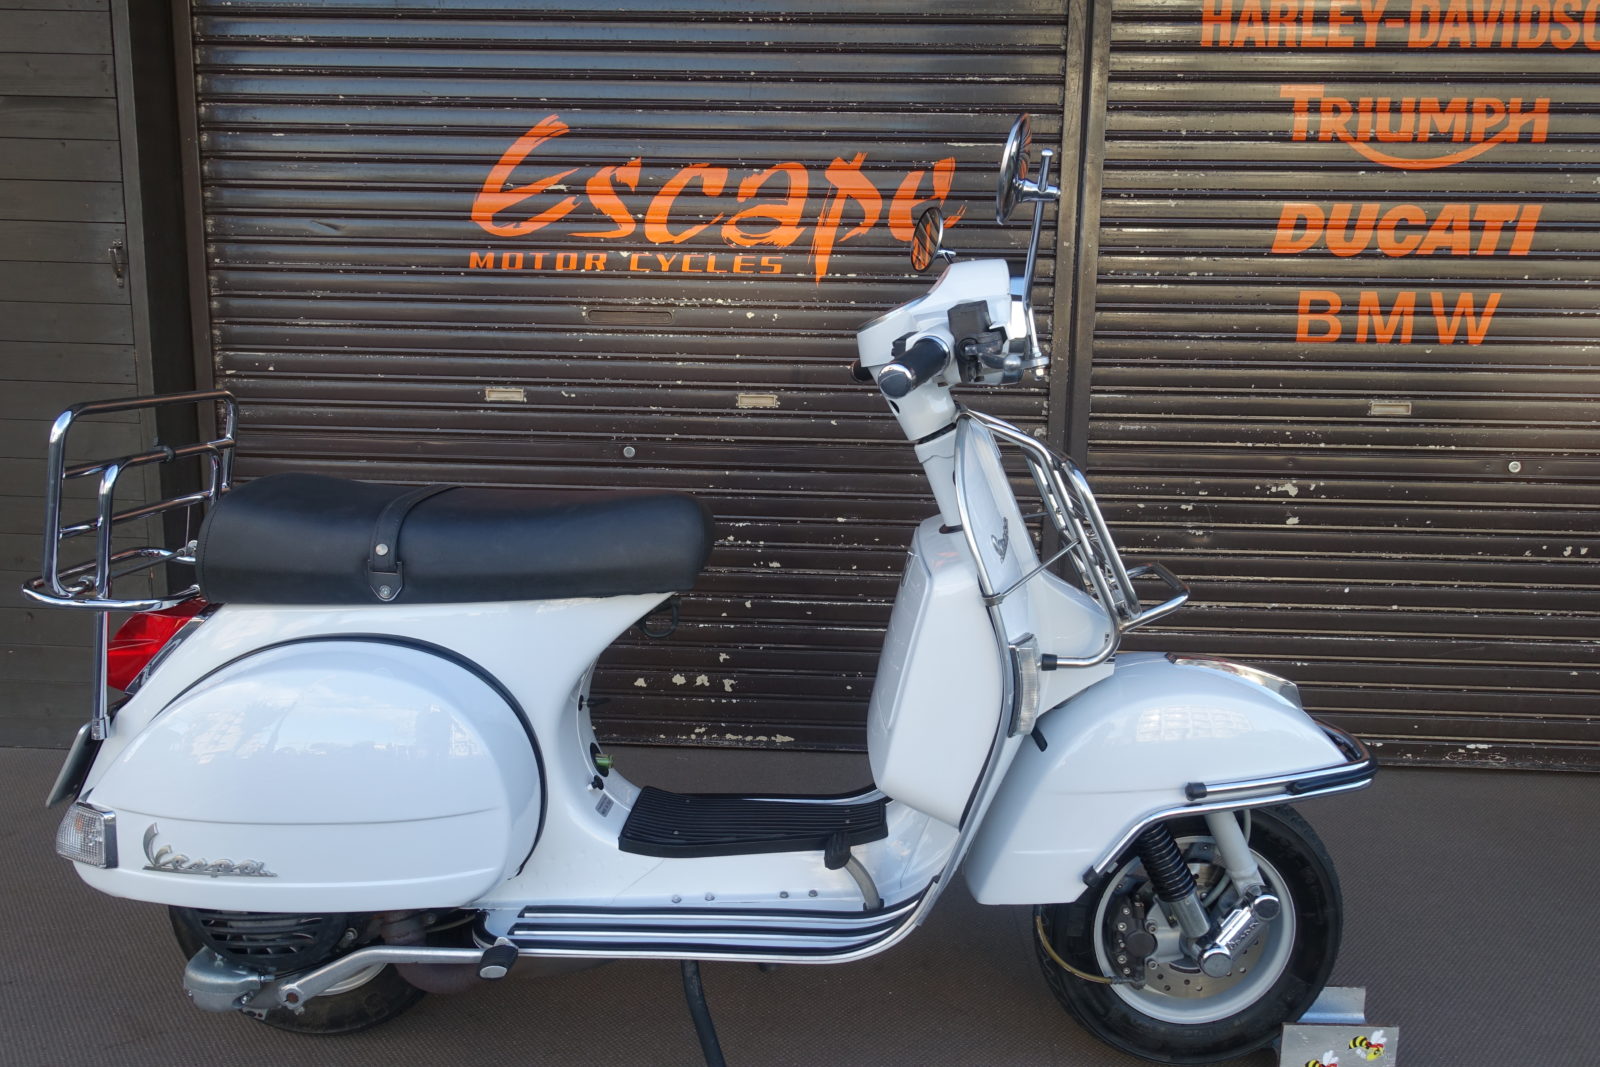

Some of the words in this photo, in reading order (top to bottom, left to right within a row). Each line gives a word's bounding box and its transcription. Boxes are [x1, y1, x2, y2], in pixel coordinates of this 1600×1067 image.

[1280, 84, 1550, 170] TRIUMPH
[470, 113, 966, 287] Escape
[1271, 203, 1543, 258] DUCATI
[469, 251, 607, 272] MOTOR
[629, 253, 784, 275] CYCLES
[1296, 290, 1502, 346] BMW
